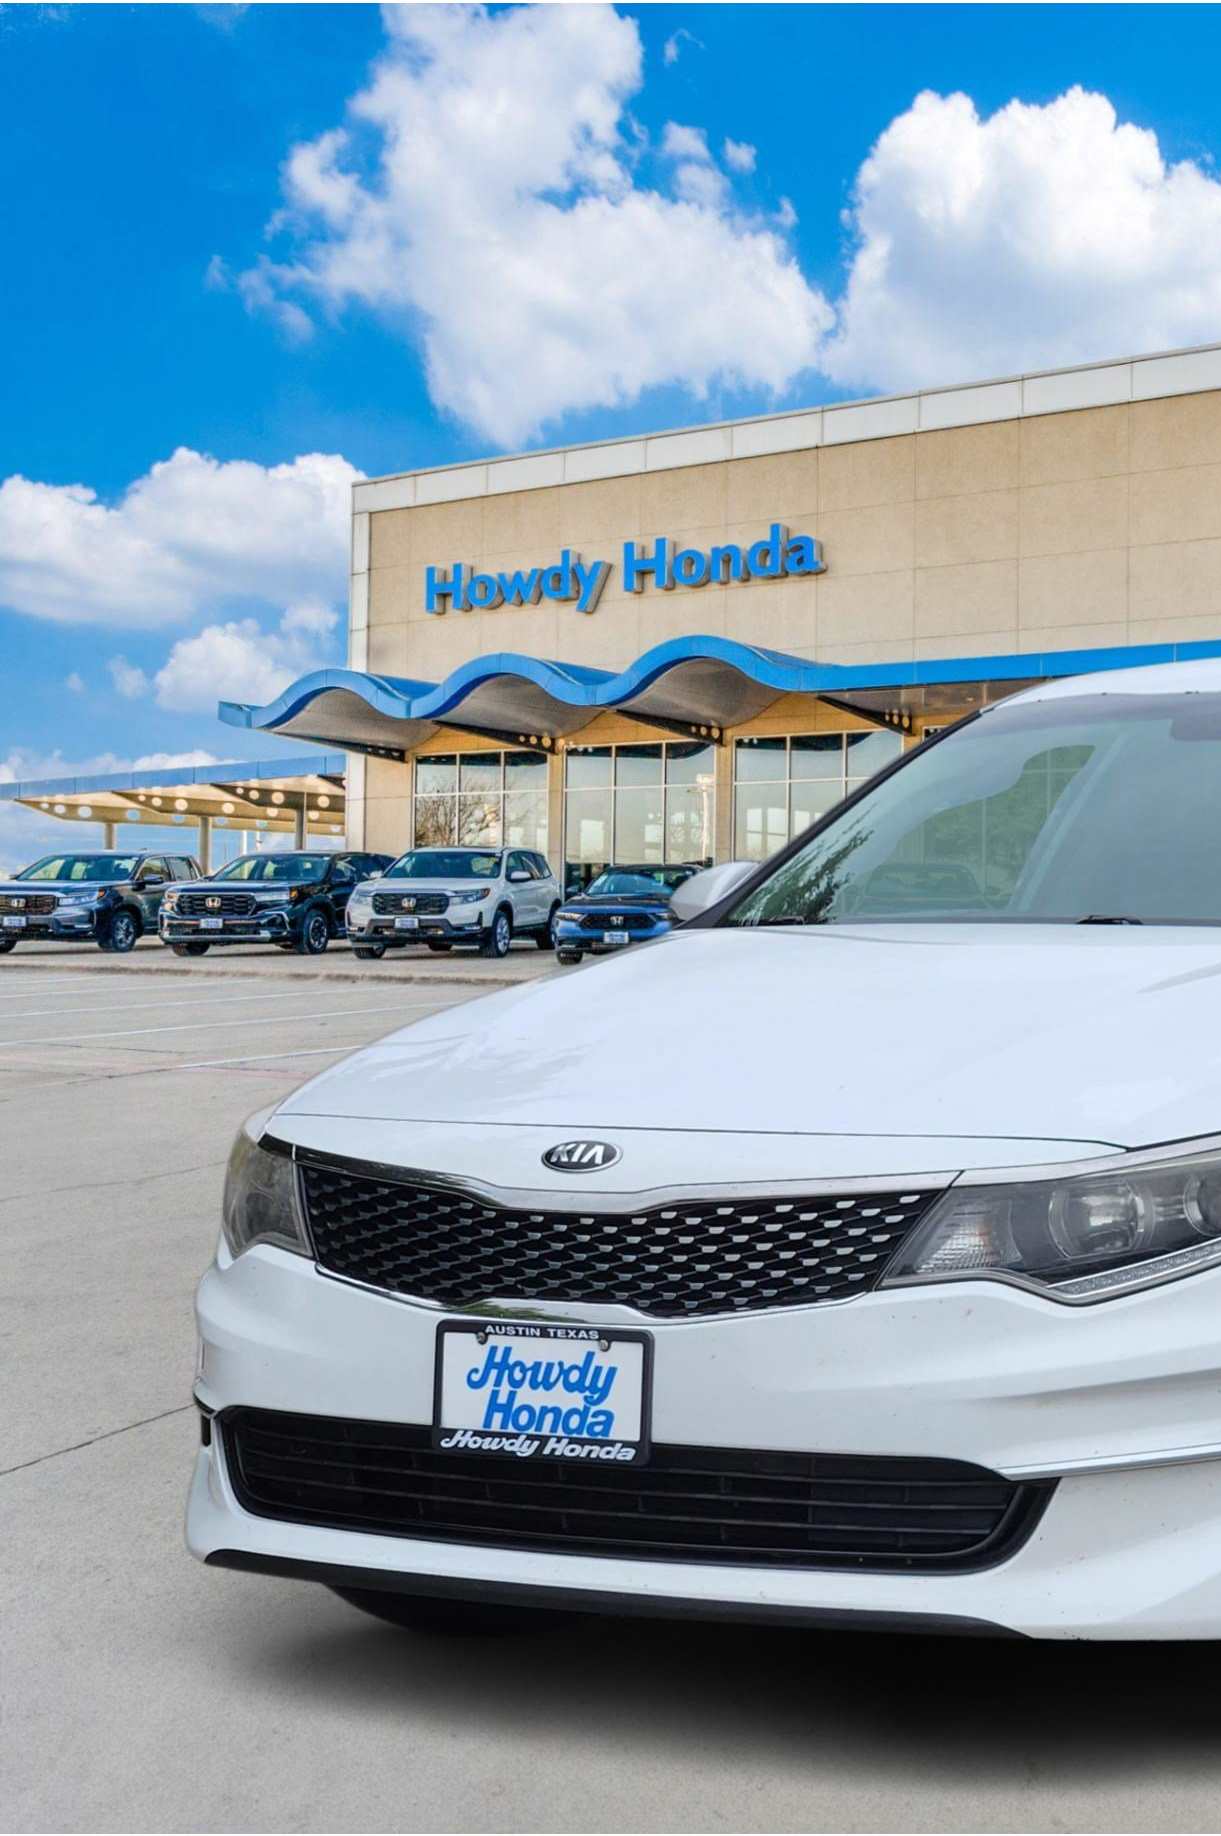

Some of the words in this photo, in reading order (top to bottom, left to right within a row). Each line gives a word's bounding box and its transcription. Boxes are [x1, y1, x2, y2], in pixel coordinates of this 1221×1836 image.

[425, 549, 612, 615] Howdy
[622, 523, 827, 594] Honda
[550, 1143, 605, 1164] KIA
[485, 1325, 541, 1337] AUSTIN
[547, 1328, 599, 1339] TEXAS
[466, 1345, 618, 1406] Howdy
[483, 1390, 615, 1438] Honda
[440, 1431, 540, 1457] Howdy
[543, 1437, 636, 1461] Honda
